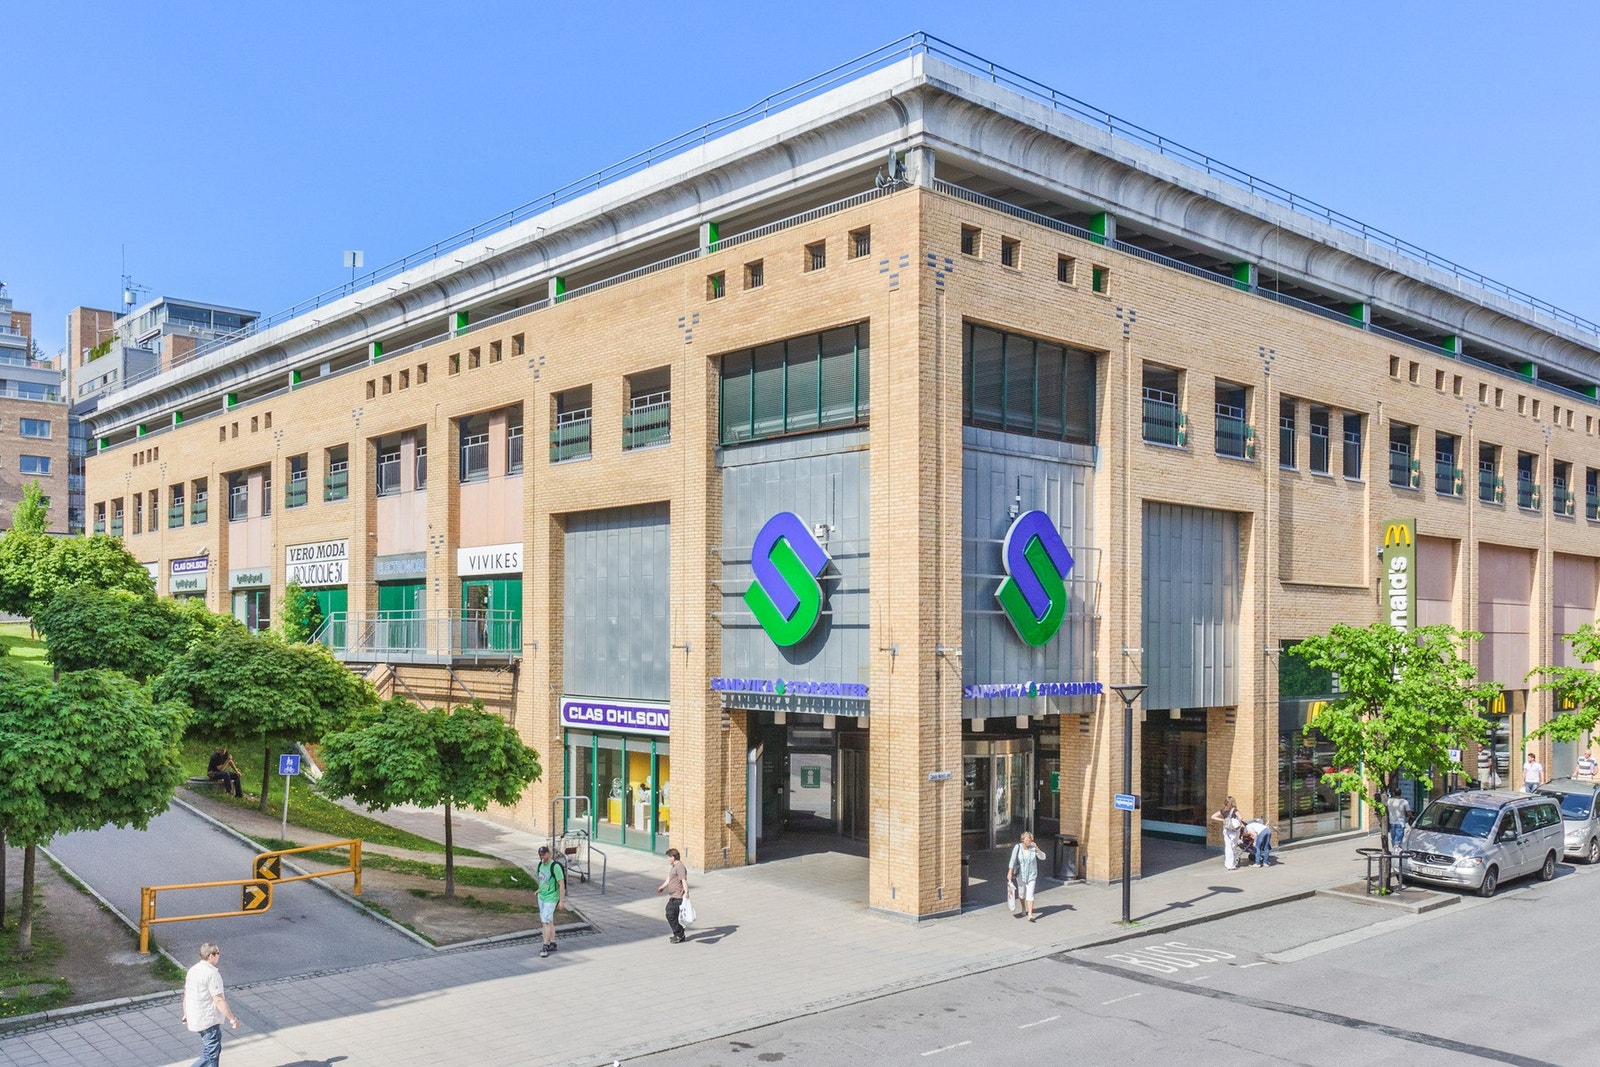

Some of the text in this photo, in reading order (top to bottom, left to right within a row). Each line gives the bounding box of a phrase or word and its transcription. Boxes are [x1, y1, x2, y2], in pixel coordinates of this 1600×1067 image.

[290, 543, 345, 561] VERO MODA
[469, 552, 518, 570] VIVIKES
[174, 560, 207, 571] CLAS OHLSON
[335, 562, 343, 583] 31
[711, 678, 869, 698] SANDVIKA STORSENTER
[964, 682, 1104, 699] SANDVIKA STORSENTER
[568, 706, 669, 727] CLAS OHLSON
[1104, 941, 1236, 973] BUSS
